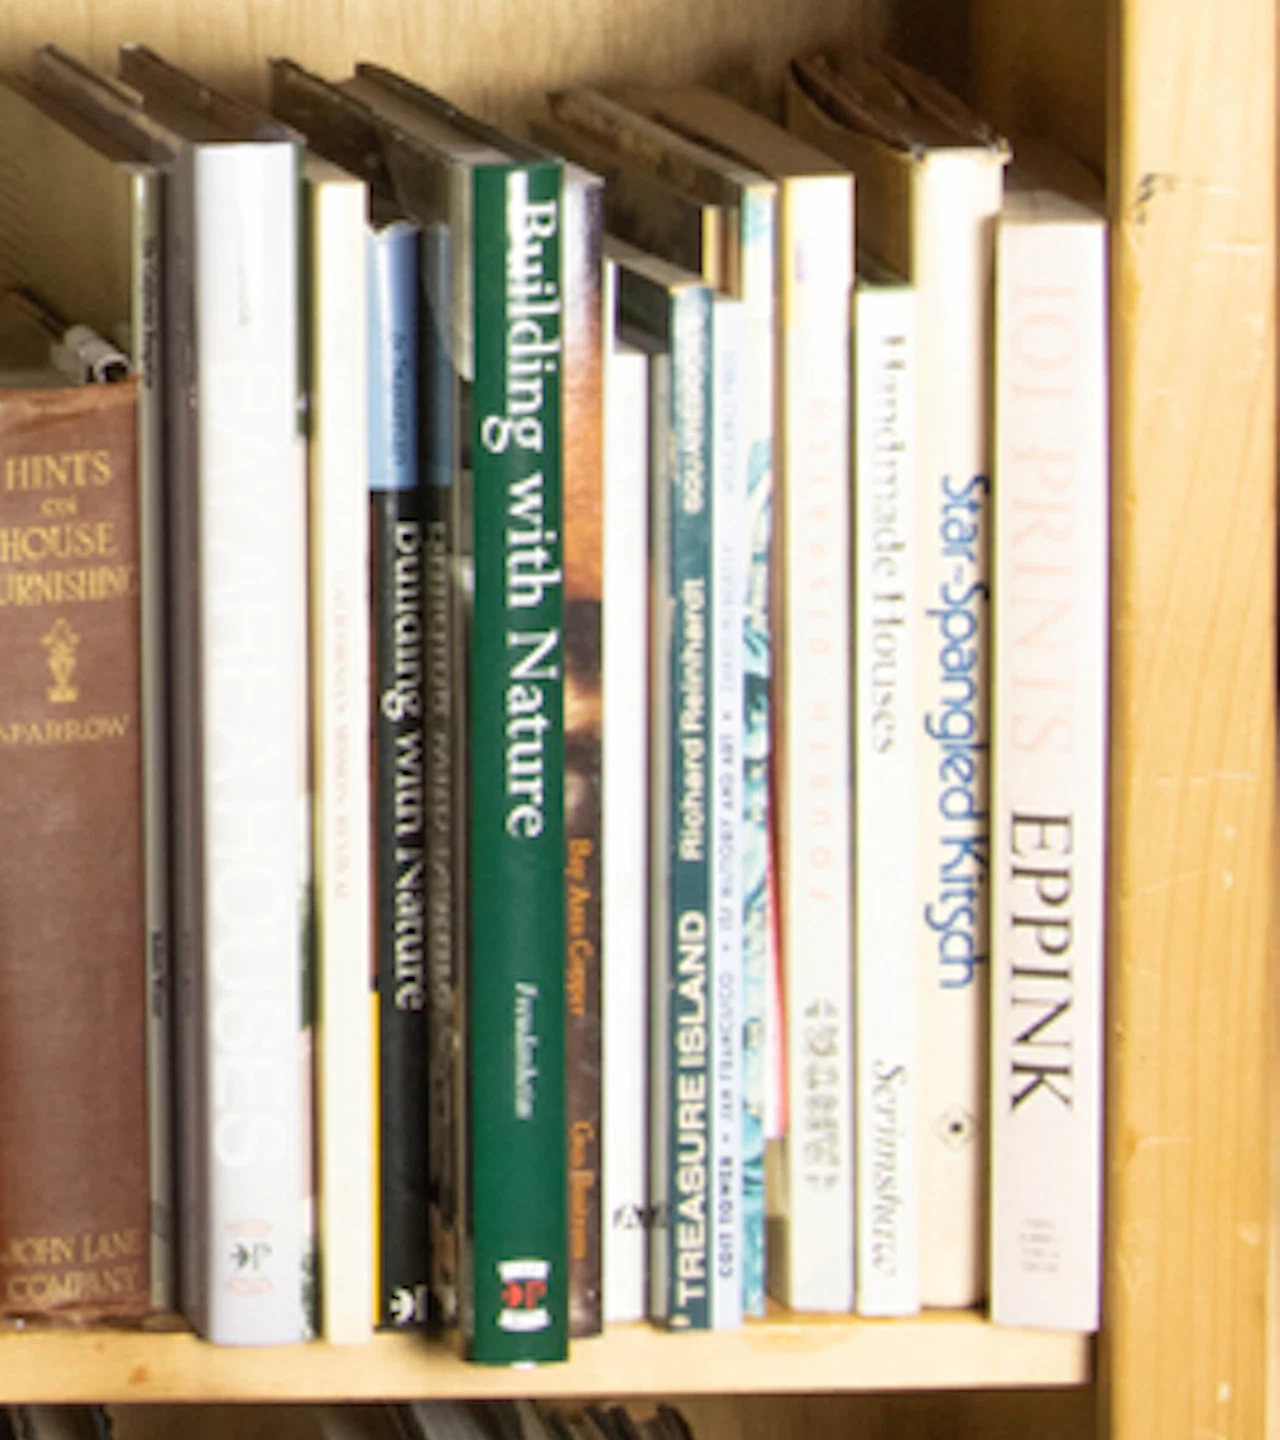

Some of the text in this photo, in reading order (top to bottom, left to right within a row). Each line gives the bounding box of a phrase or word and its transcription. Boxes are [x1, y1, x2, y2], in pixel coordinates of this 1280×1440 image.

[3, 452, 112, 488] HINTS
[484, 198, 562, 838] Building with Nature
[931, 835, 989, 989] Kitsch
[1007, 809, 1073, 1112] EPPINK
